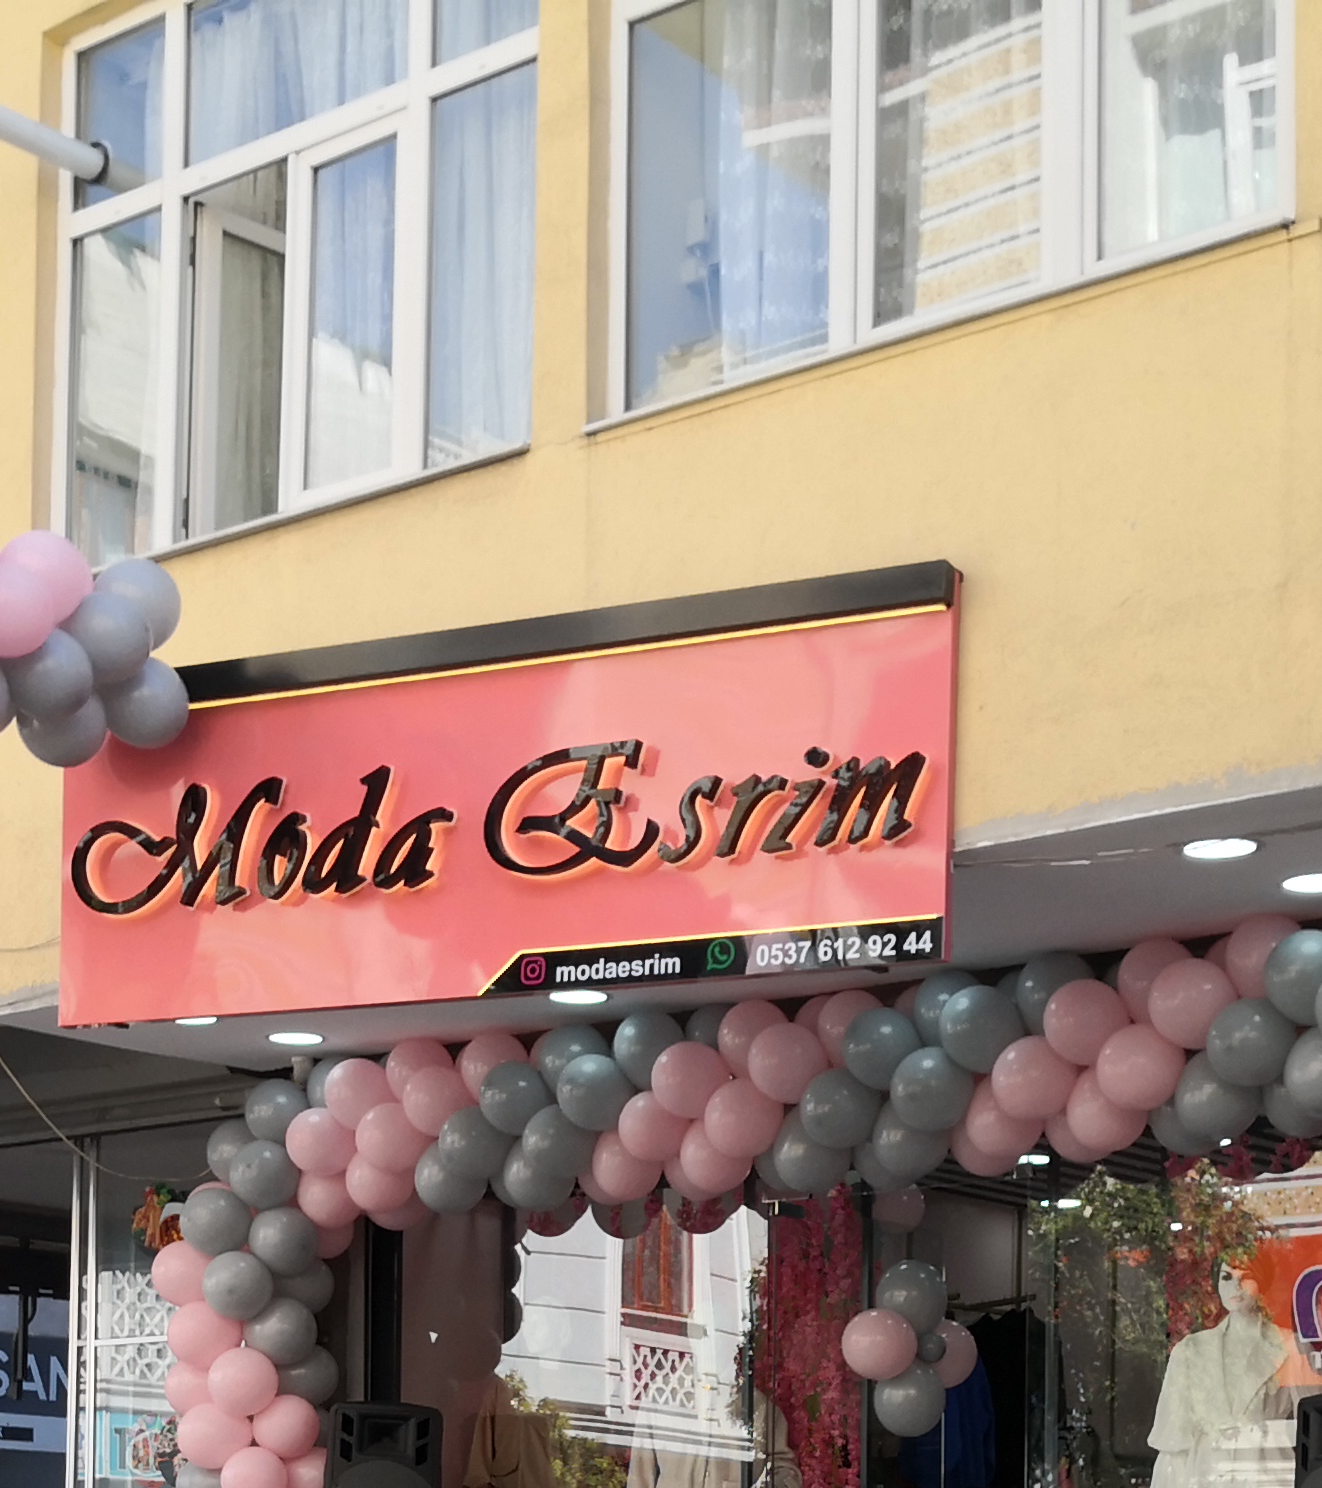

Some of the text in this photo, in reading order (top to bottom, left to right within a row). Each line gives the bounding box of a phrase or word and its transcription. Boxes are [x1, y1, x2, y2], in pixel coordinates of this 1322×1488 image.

[71, 738, 929, 916] Moda Esrim
[756, 930, 933, 967] 0537 612 92 44
[555, 953, 681, 984] modaesrim
